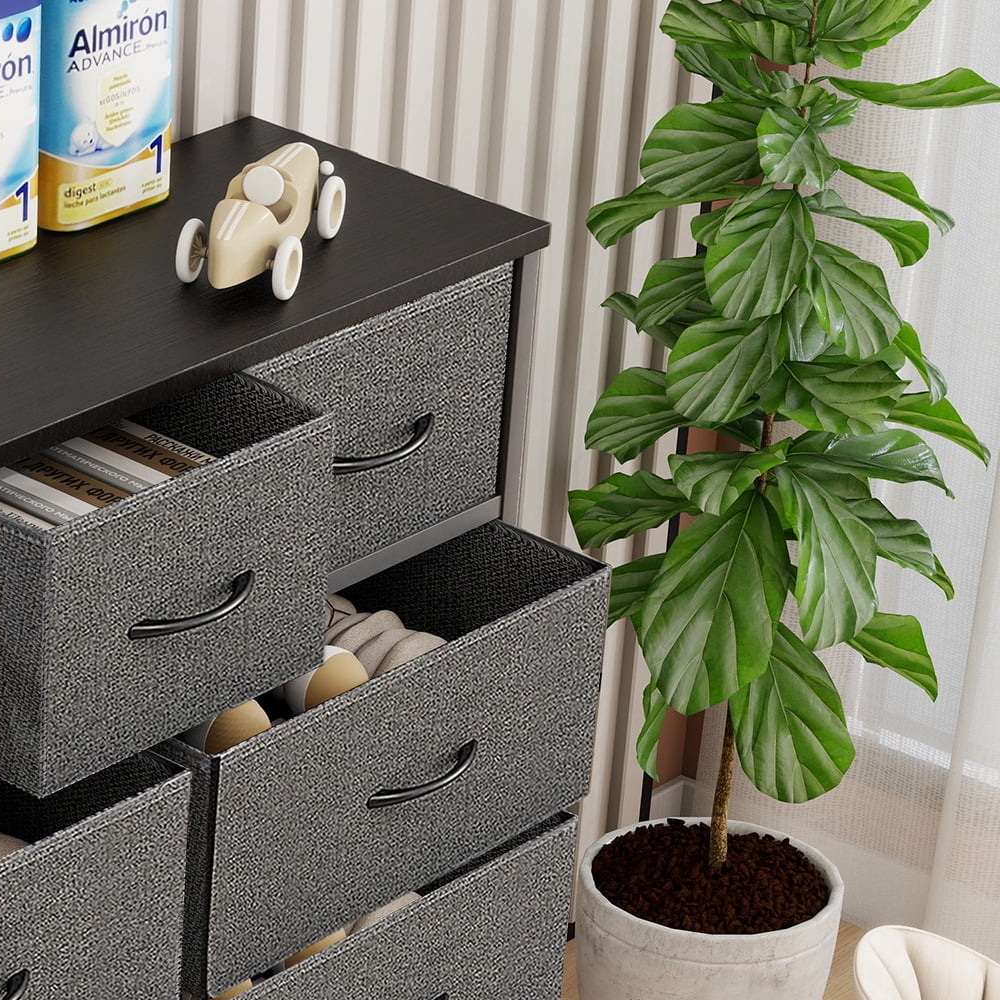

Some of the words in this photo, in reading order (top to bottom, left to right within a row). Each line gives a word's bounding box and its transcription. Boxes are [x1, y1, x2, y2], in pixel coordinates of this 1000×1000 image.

[68, 8, 168, 58] Almirón
[66, 40, 142, 74] ADVANCE
[150, 134, 163, 174] 1
[15, 181, 29, 222] 1
[64, 183, 96, 199] digest
